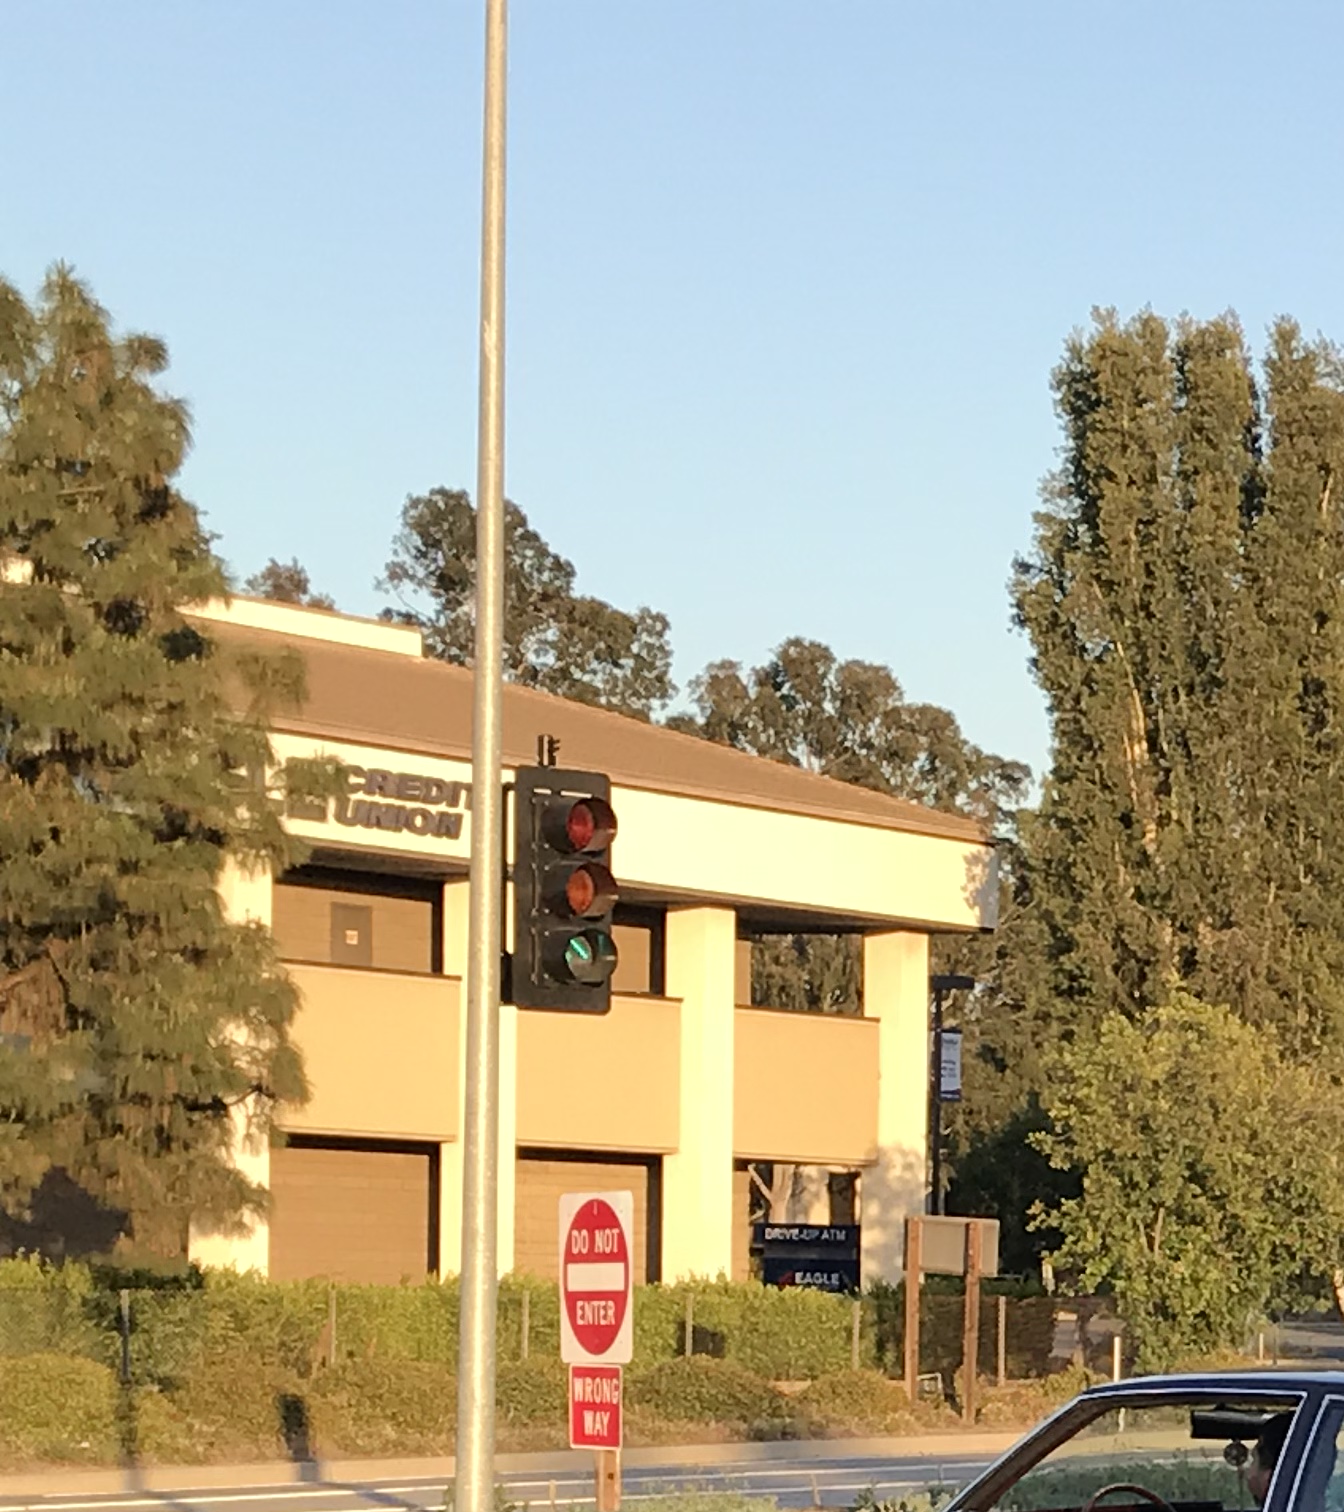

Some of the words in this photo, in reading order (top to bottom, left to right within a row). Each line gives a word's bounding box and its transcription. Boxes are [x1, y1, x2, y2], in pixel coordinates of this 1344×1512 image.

[334, 797, 464, 840] UNION
[571, 1229, 589, 1254] DO
[594, 1228, 620, 1253] NOT
[764, 1227, 819, 1241] DRIVE-UP
[821, 1228, 846, 1241] ATM
[794, 1271, 840, 1285] EAGLE
[576, 1300, 616, 1326] ENTER
[573, 1376, 619, 1405] WRONG
[583, 1411, 611, 1436] WAY
